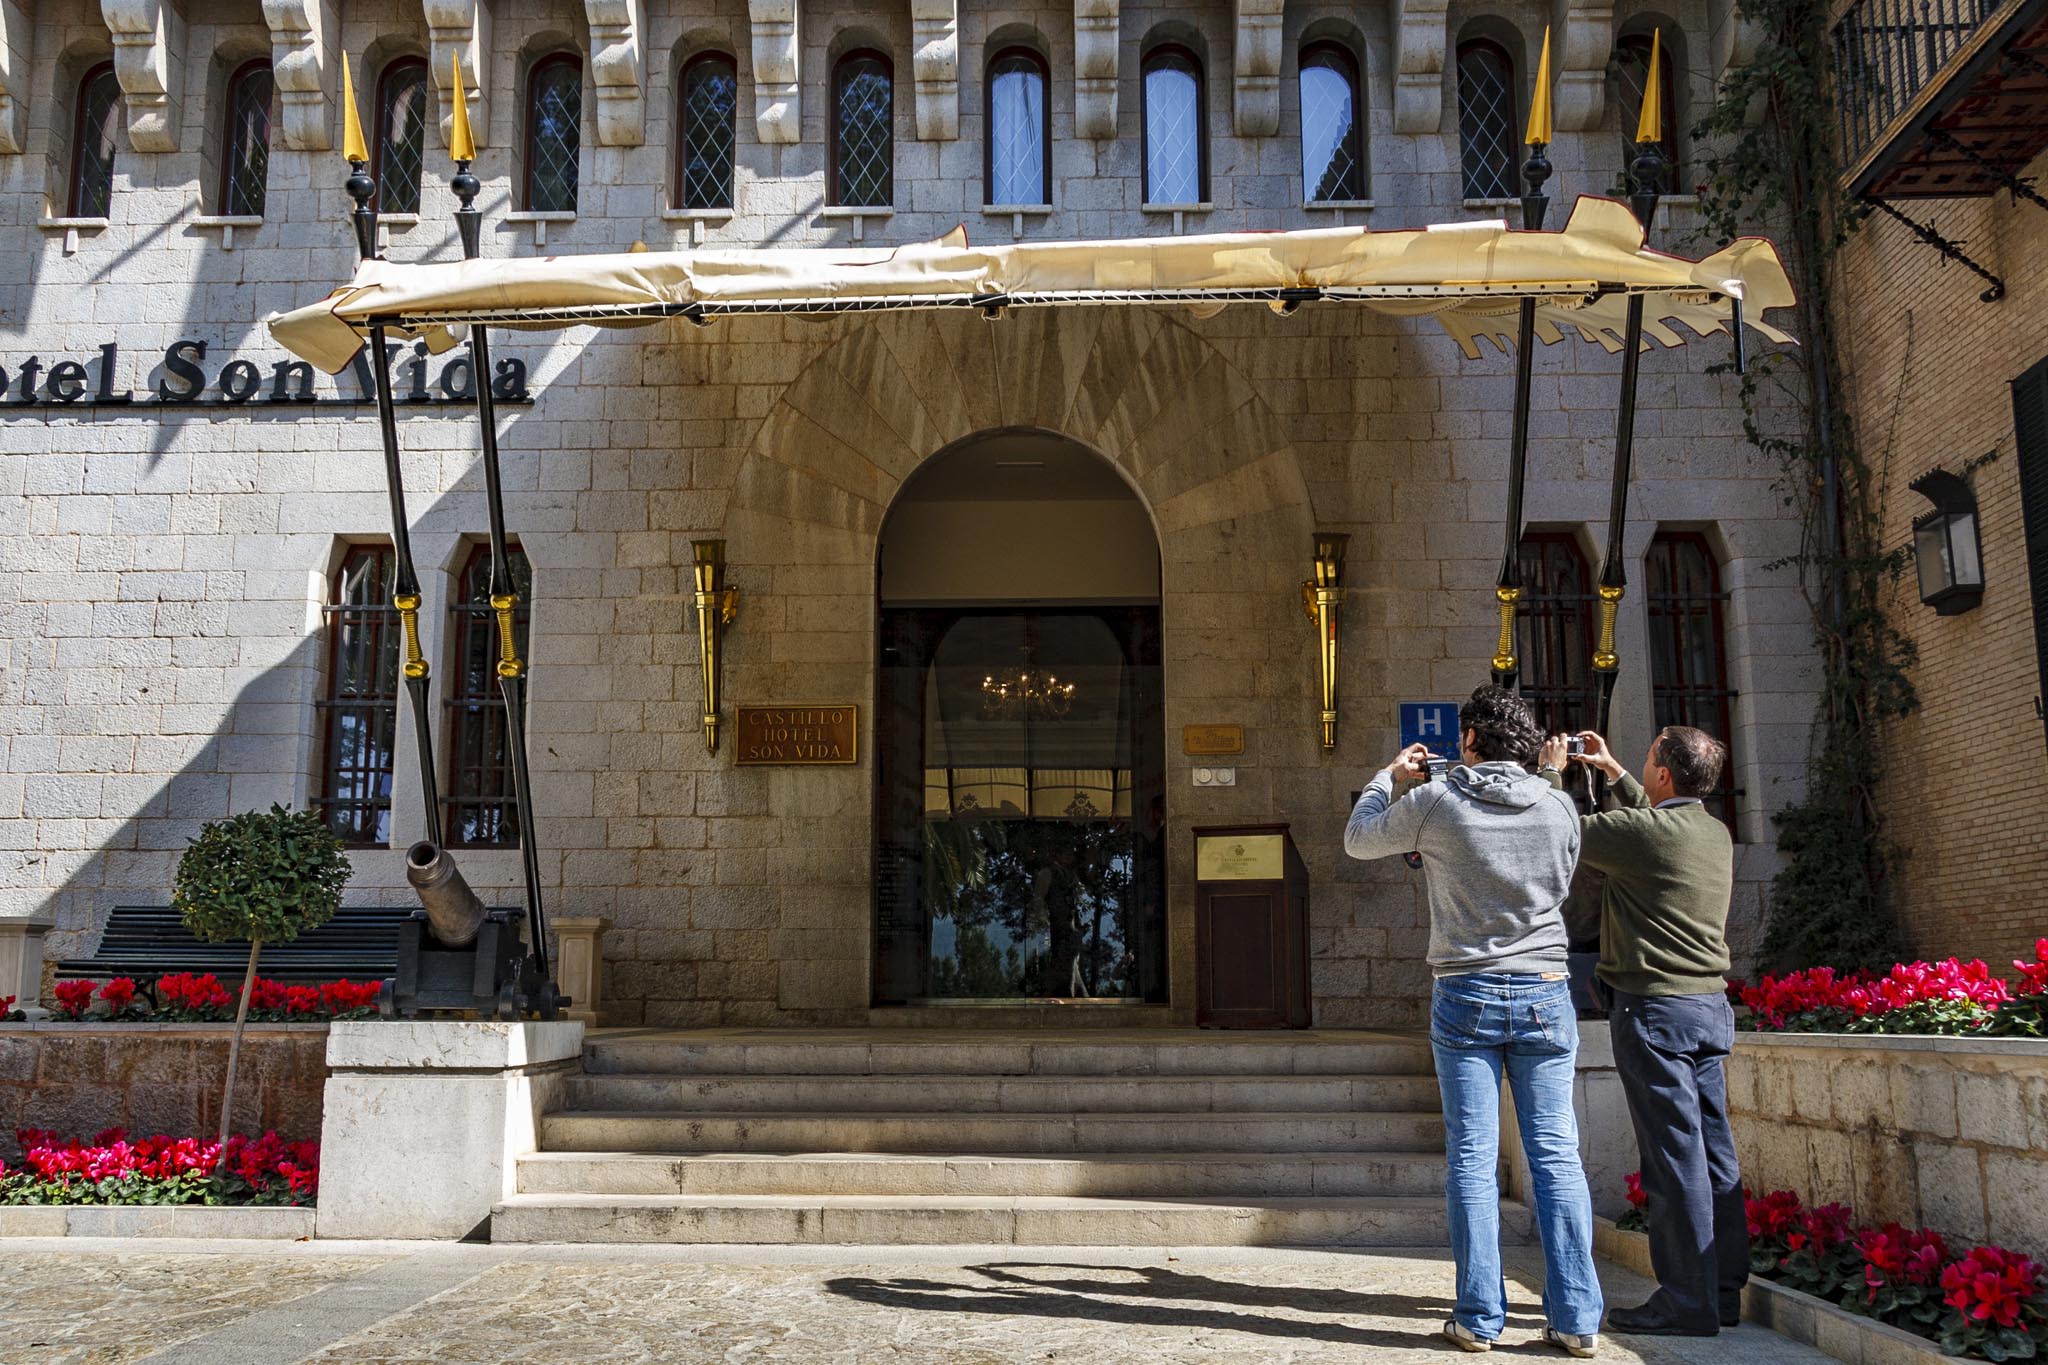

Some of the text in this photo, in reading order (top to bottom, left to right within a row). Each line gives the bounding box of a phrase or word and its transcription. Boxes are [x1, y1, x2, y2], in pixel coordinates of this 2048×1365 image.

[0, 340, 530, 404] tel Son Vida
[750, 711, 843, 725] CASTILLO
[1418, 708, 1441, 736] H
[764, 728, 826, 742] HOTEL
[750, 744, 841, 759] SON VIDA
